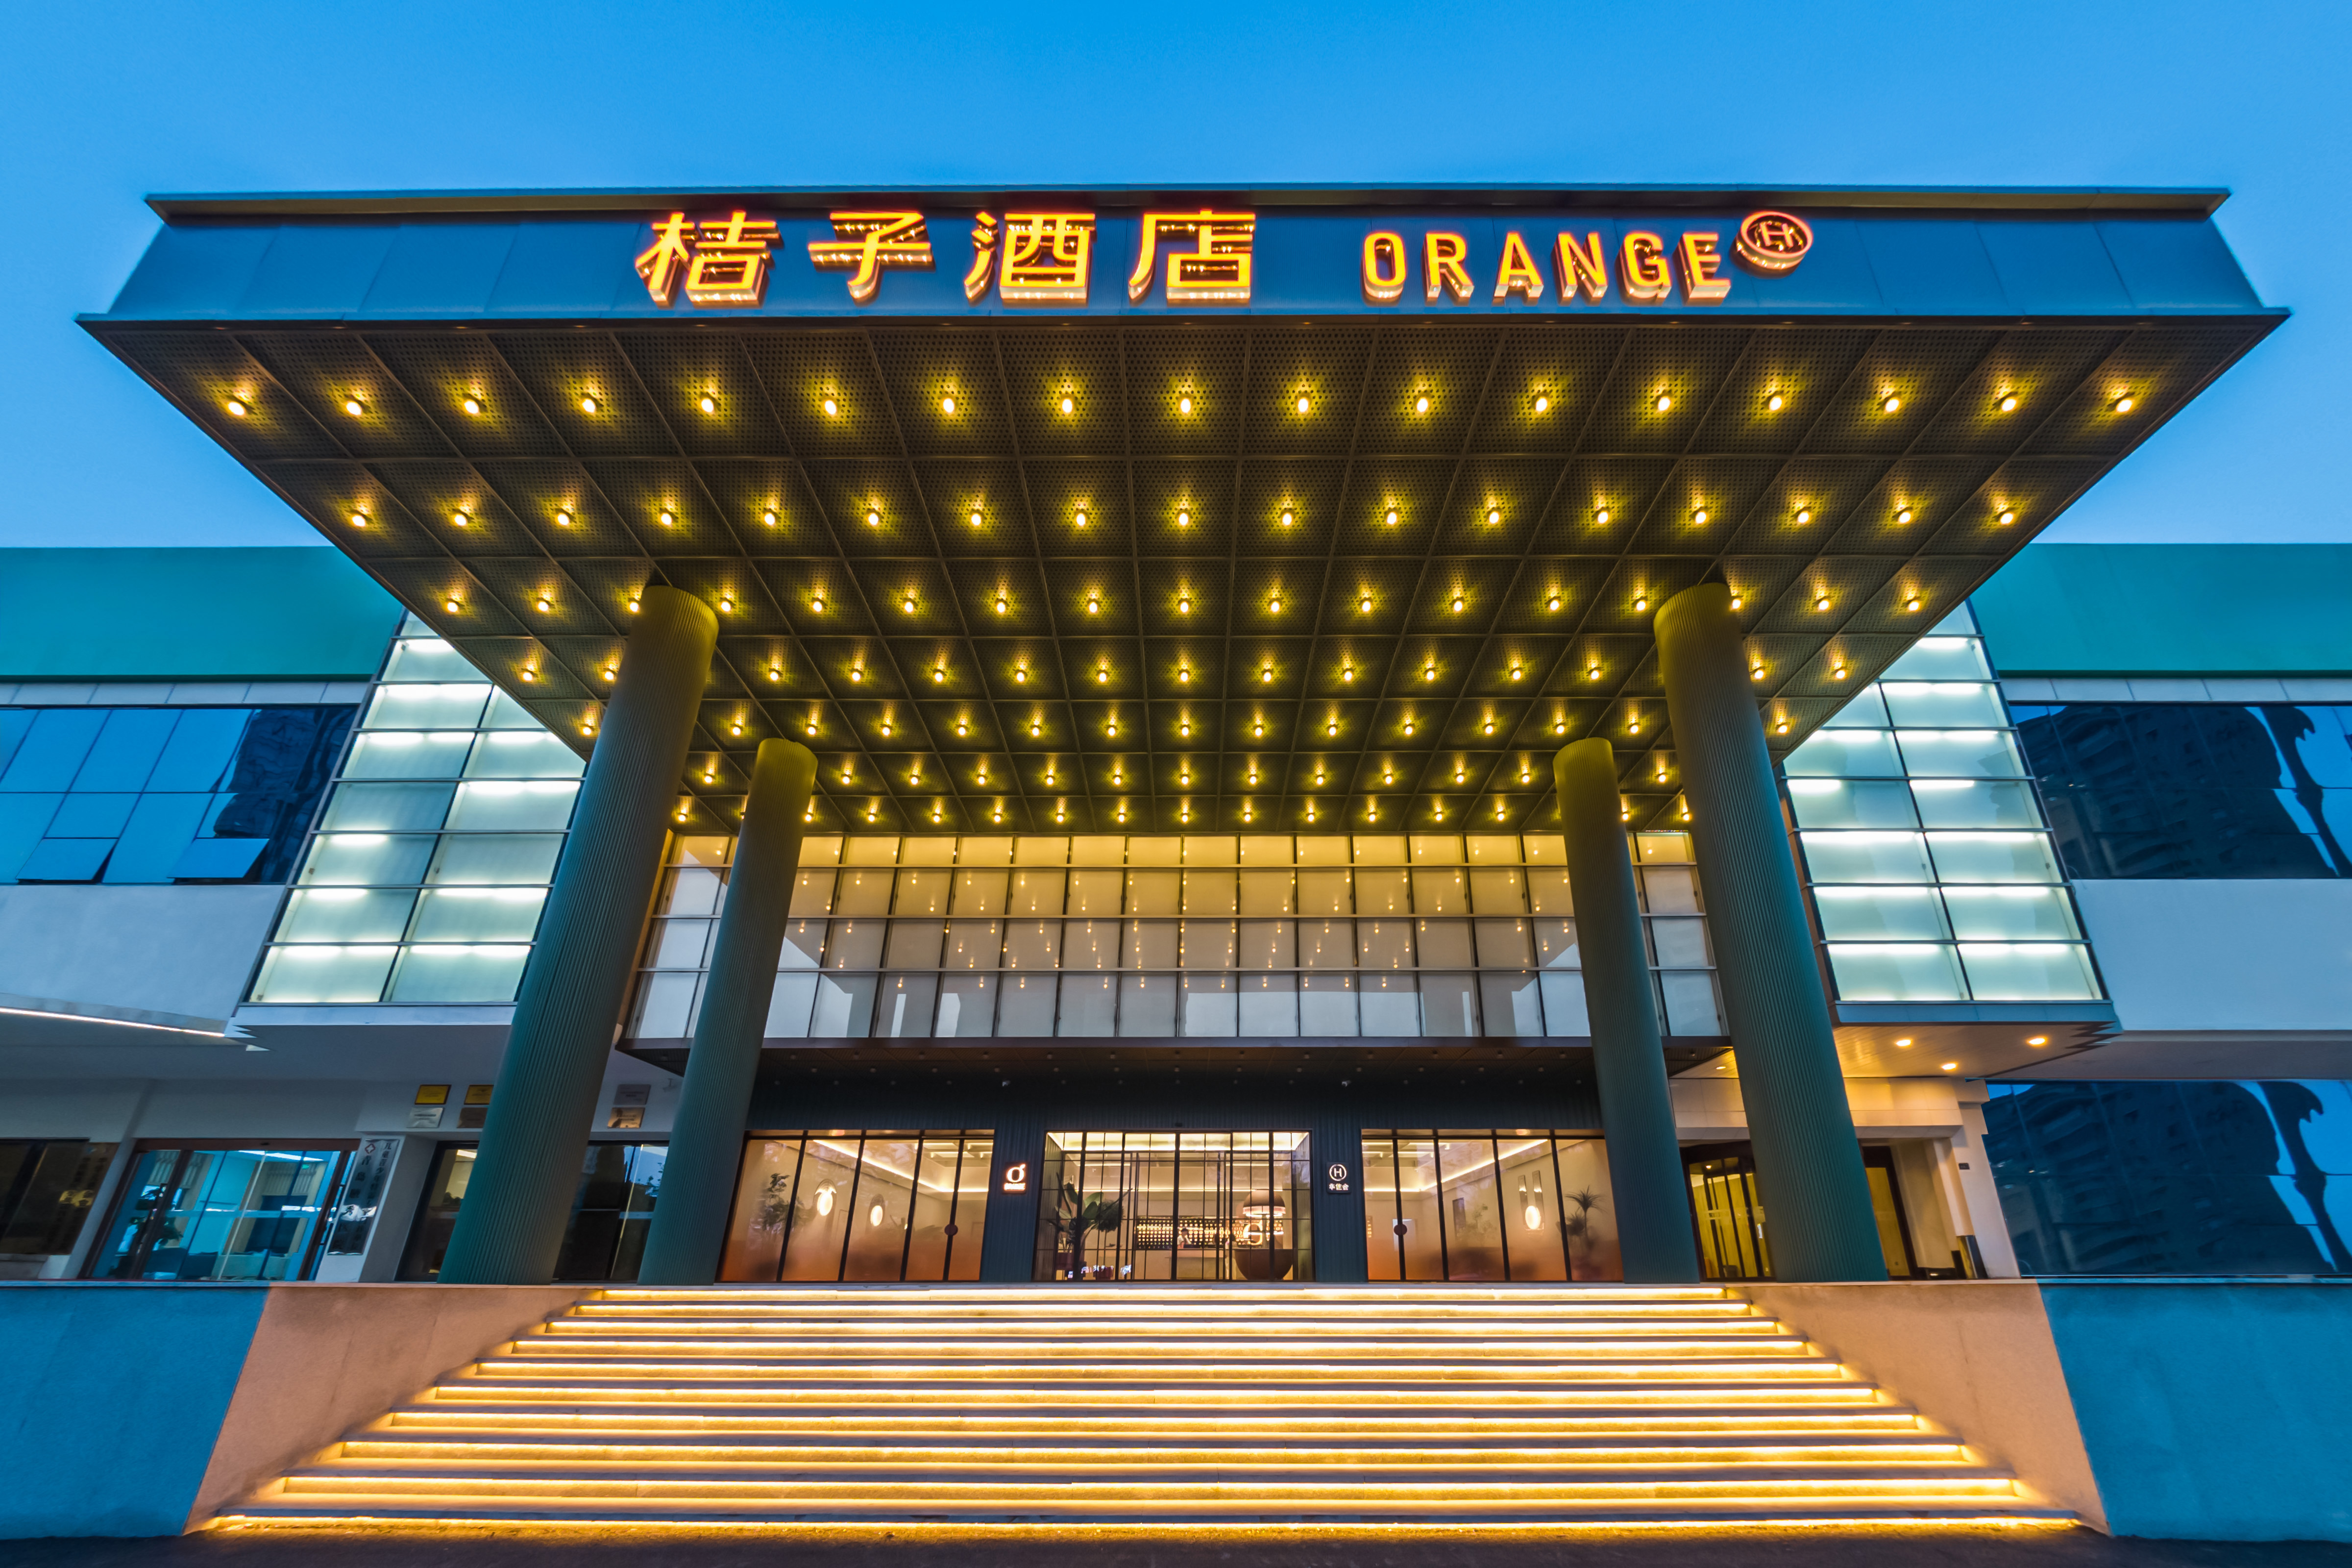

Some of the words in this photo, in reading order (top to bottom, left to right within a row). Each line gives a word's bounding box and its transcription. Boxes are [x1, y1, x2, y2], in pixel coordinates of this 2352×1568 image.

[635, 209, 1257, 300] 桔子酒店
[1362, 231, 1731, 296] ORANGE
